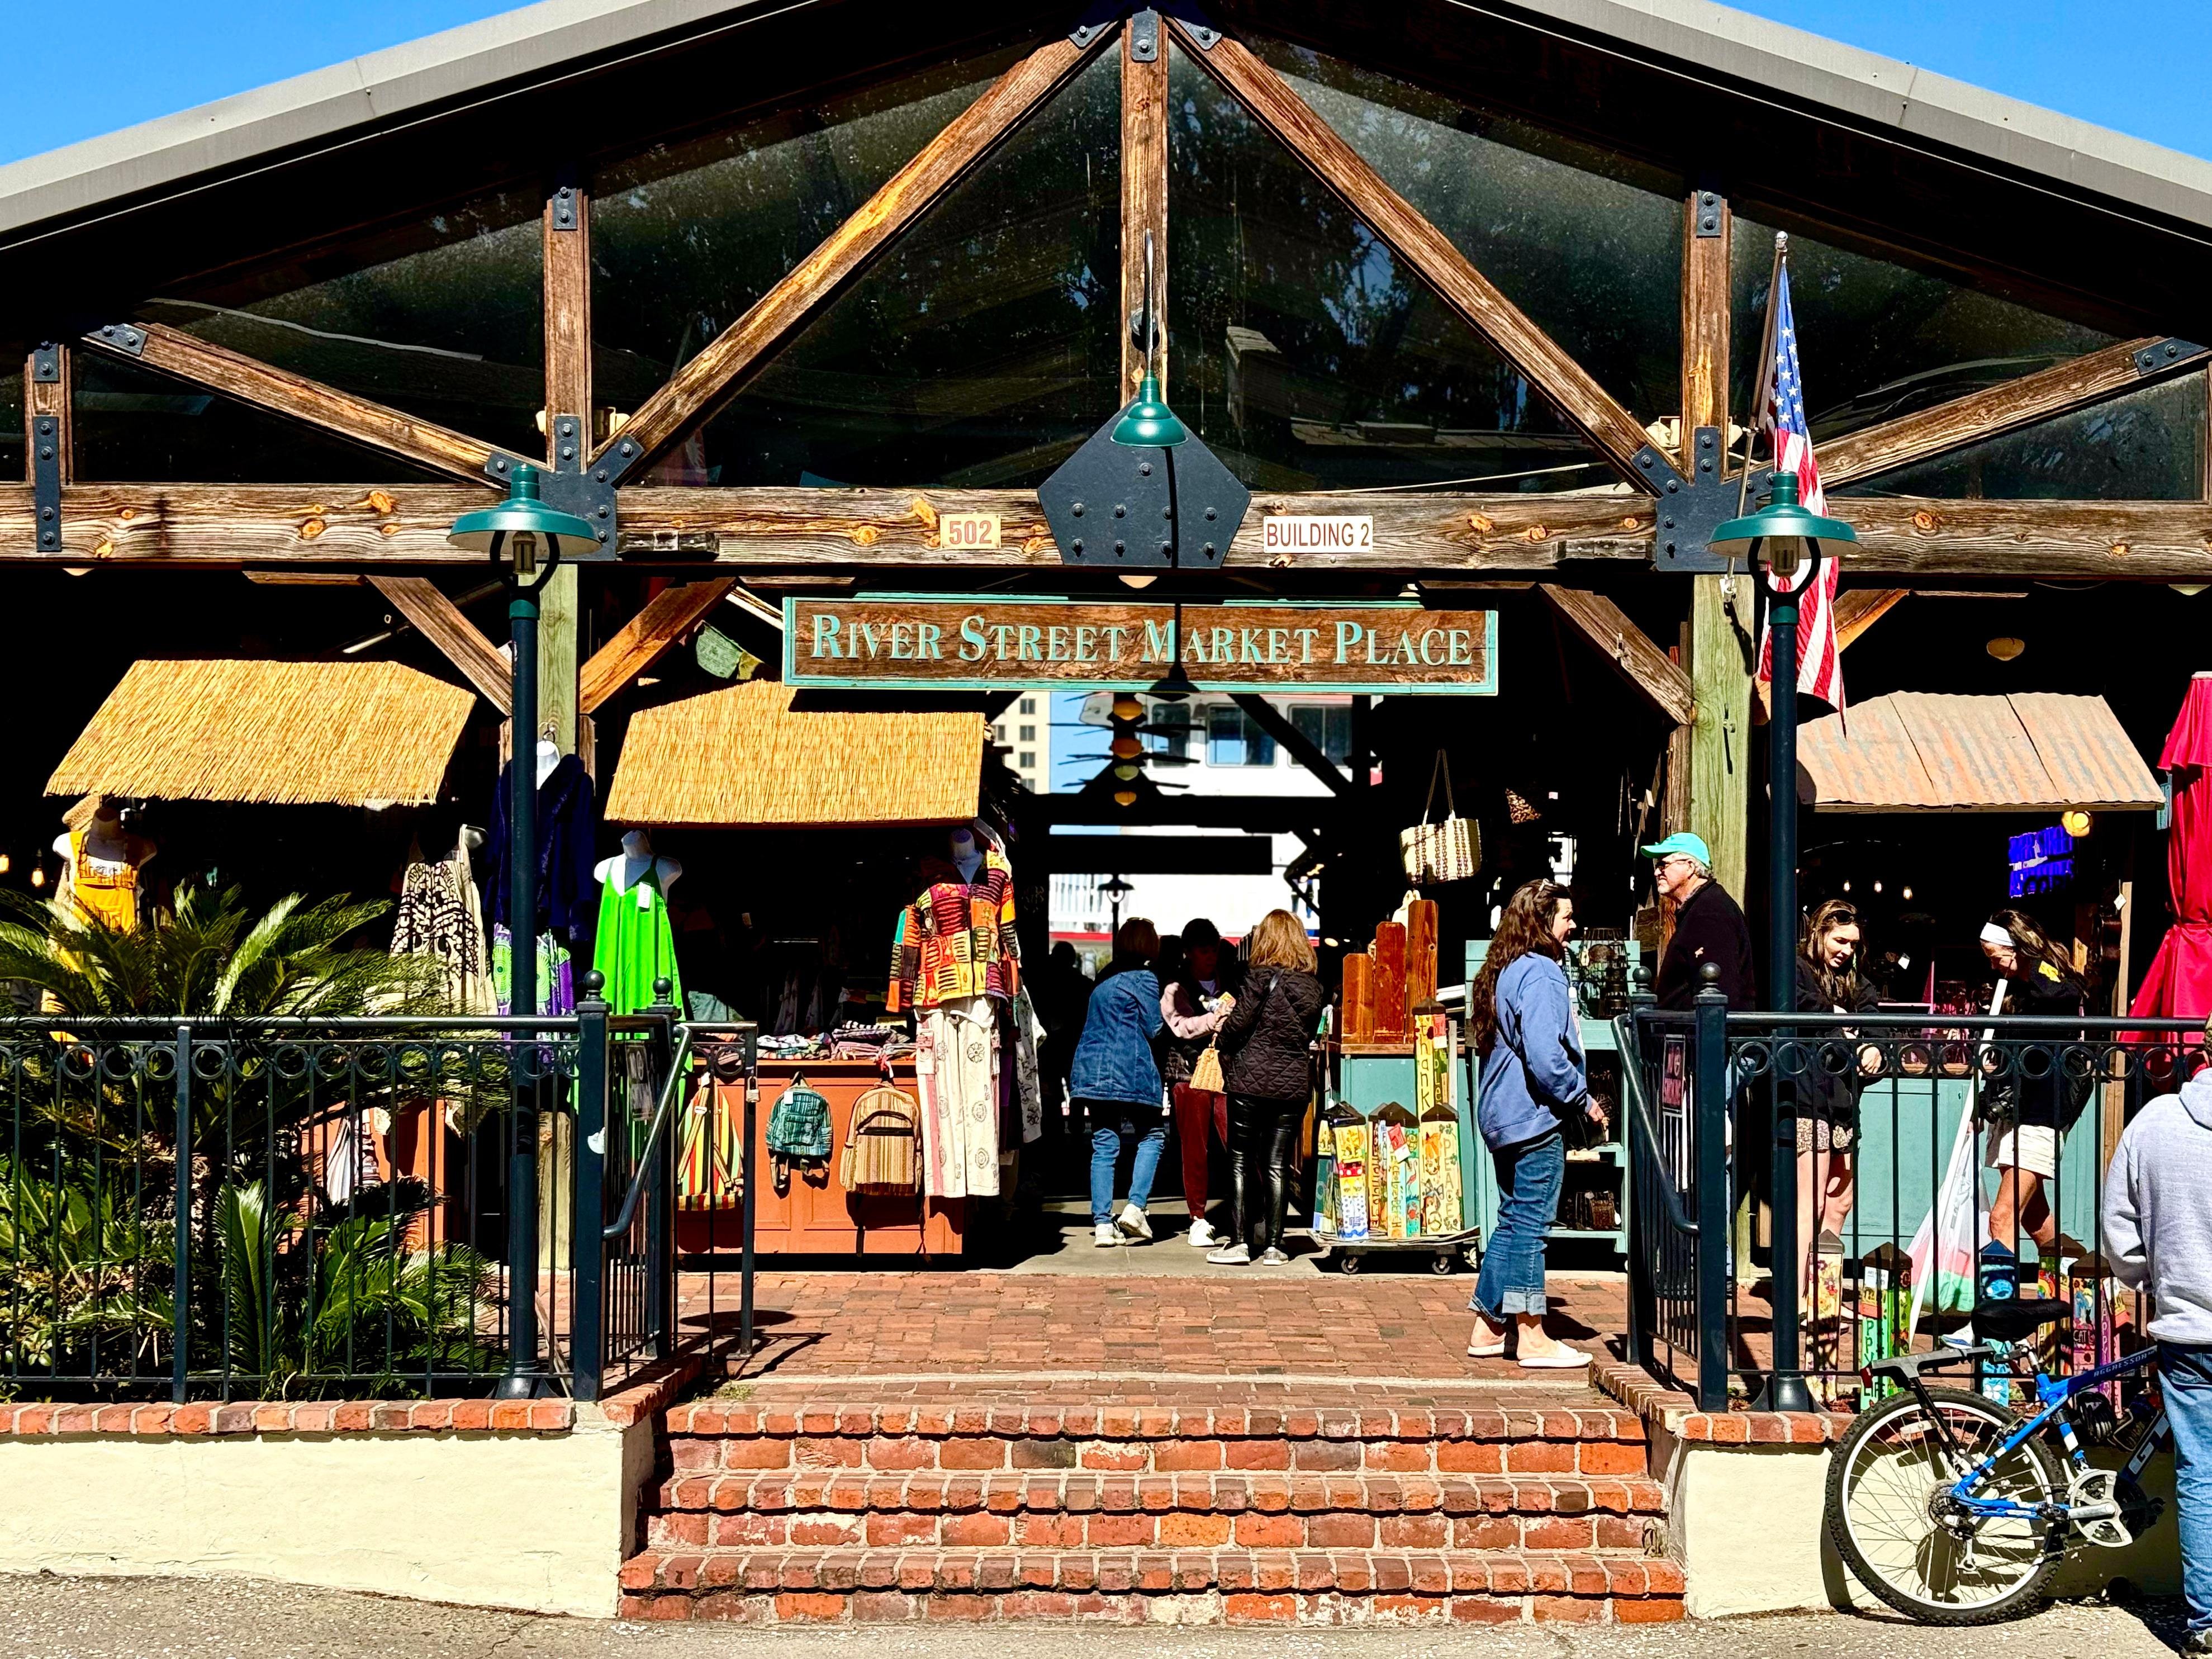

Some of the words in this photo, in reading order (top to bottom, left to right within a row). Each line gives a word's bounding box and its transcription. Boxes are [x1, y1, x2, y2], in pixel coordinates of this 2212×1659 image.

[949, 520, 992, 544] 502
[1267, 523, 1355, 547] BUILDING
[1360, 524, 1370, 546] 2
[811, 614, 942, 661] RIVER
[959, 615, 1127, 663] STREET
[1142, 619, 1319, 665] MARKET
[1333, 620, 1473, 667] PLACE
[1443, 1138, 1455, 1219] PEACE
[2094, 1352, 2147, 1377] AGGRESSOR
